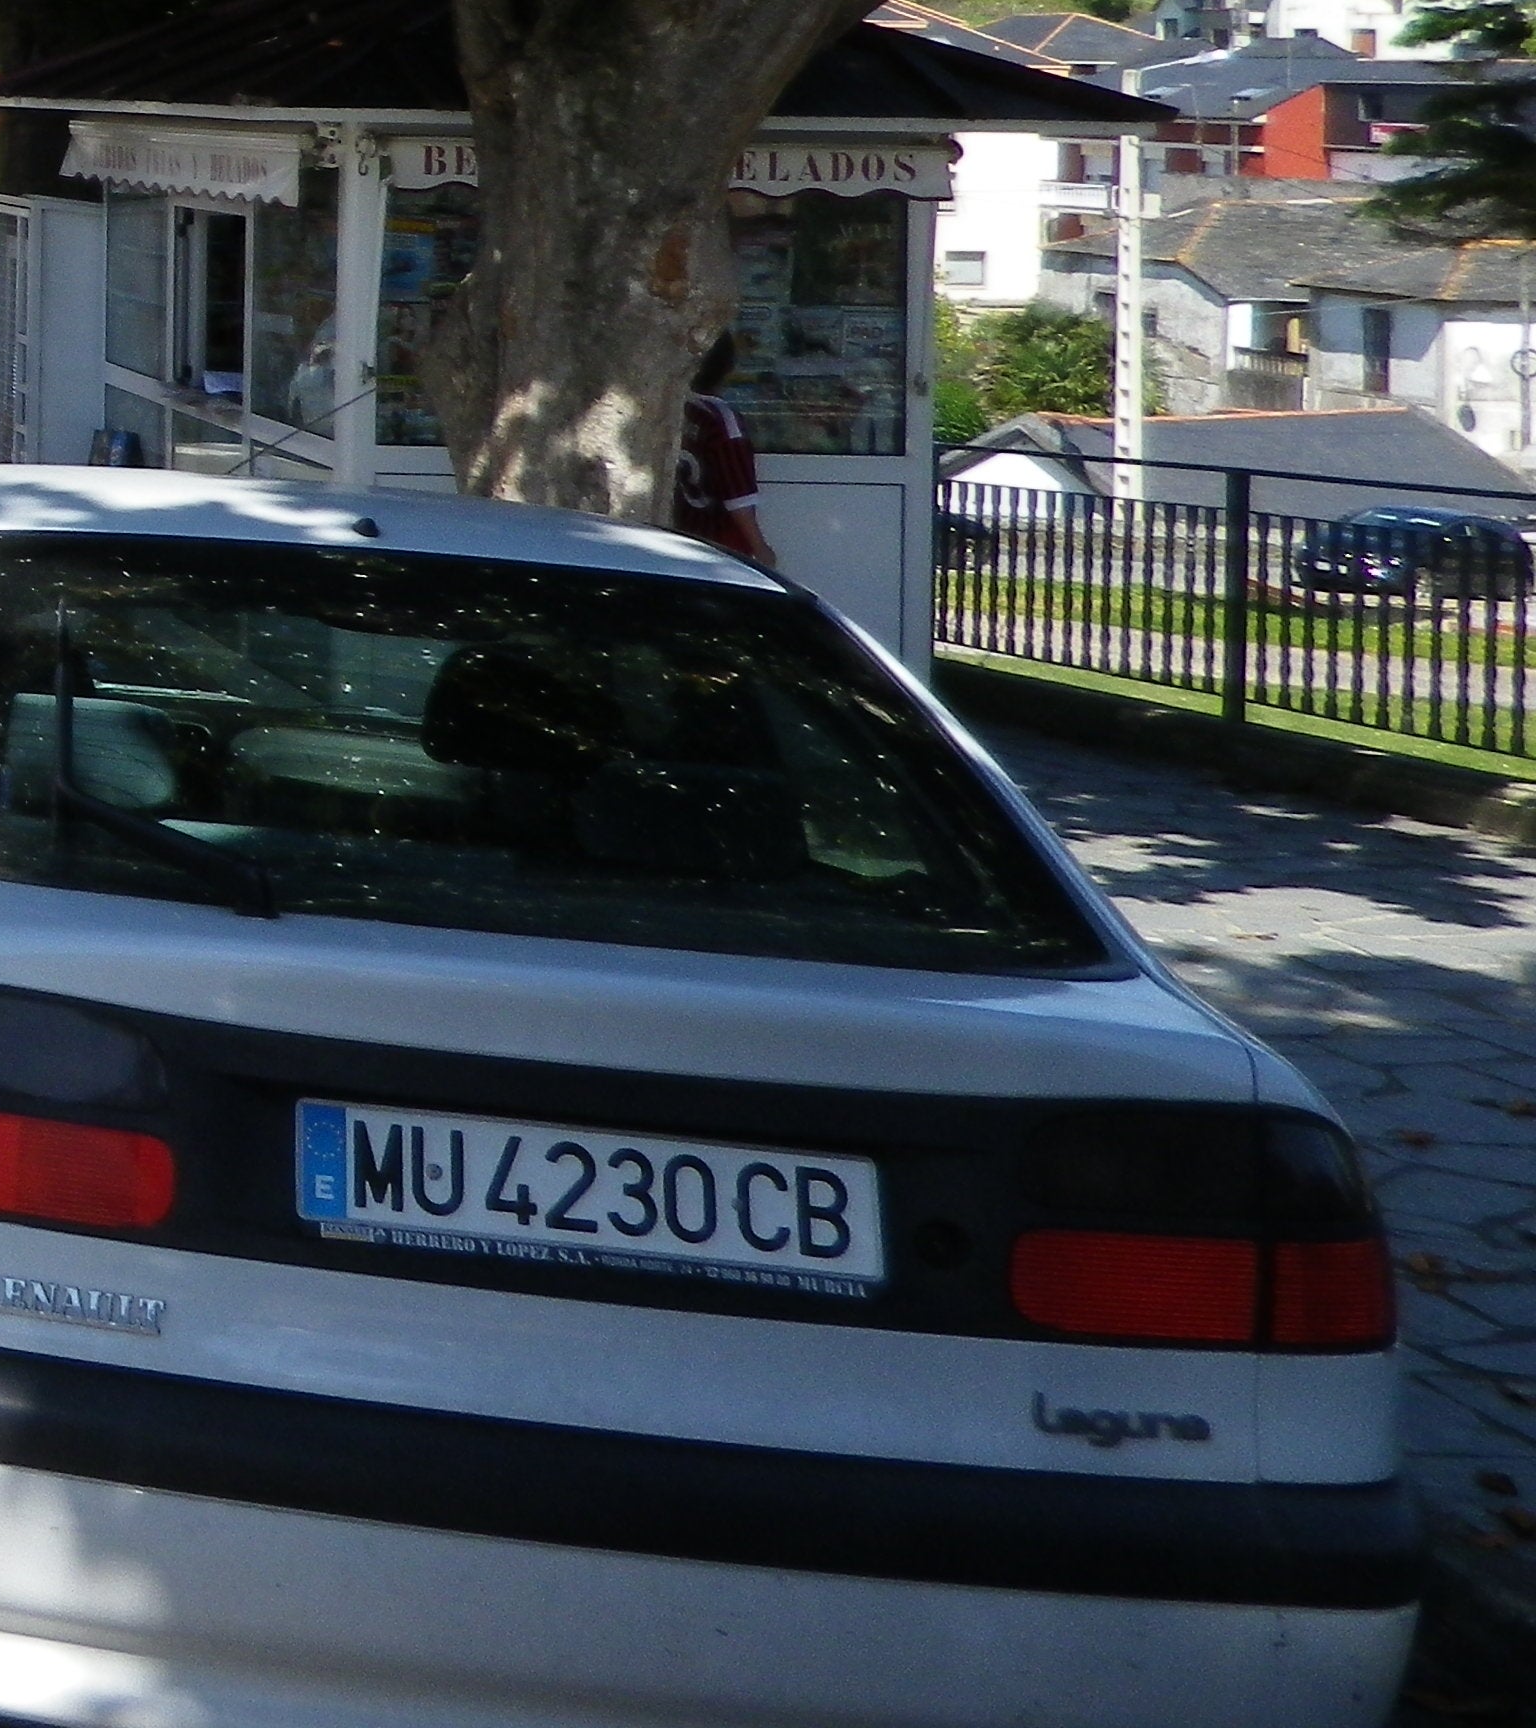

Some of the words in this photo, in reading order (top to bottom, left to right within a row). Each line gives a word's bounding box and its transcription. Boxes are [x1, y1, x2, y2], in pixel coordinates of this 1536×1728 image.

[423, 145, 477, 176] BE
[731, 151, 919, 183] ELADOS
[314, 1174, 334, 1200] E
[353, 1120, 464, 1216] MU
[486, 1136, 717, 1244] 4230
[737, 1161, 850, 1258] CB
[391, 1230, 476, 1253] HERRERO
[481, 1240, 492, 1255] Y
[497, 1242, 550, 1262] LOPEZ
